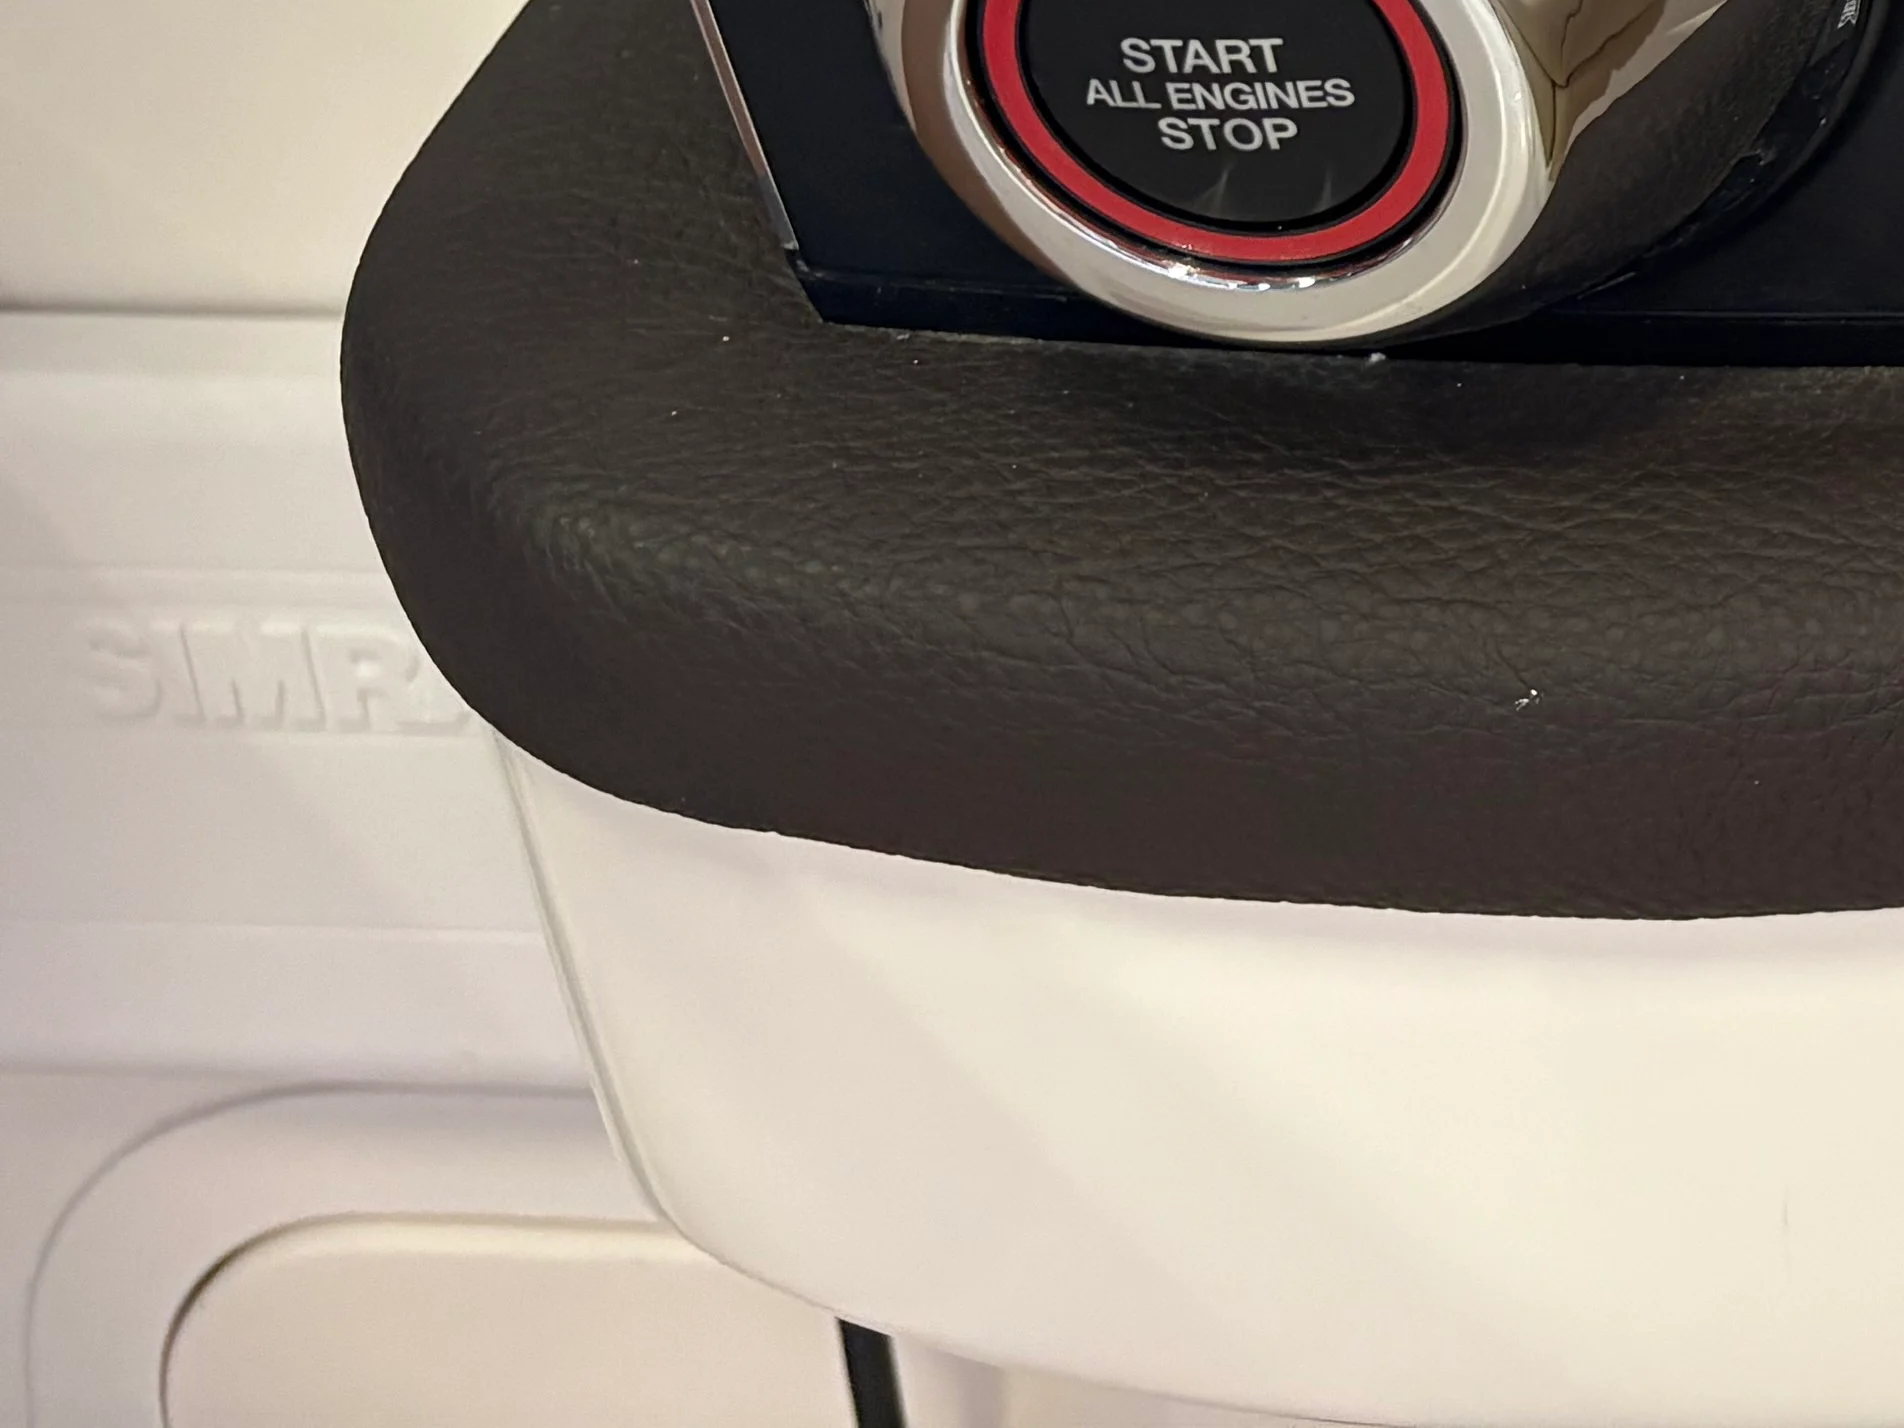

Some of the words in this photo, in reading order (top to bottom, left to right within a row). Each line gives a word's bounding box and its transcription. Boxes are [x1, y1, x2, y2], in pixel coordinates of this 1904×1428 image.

[1120, 37, 1283, 74] START
[1086, 78, 1161, 109] ALL
[1165, 77, 1355, 111] ENGINES
[1157, 116, 1298, 151] STOP
